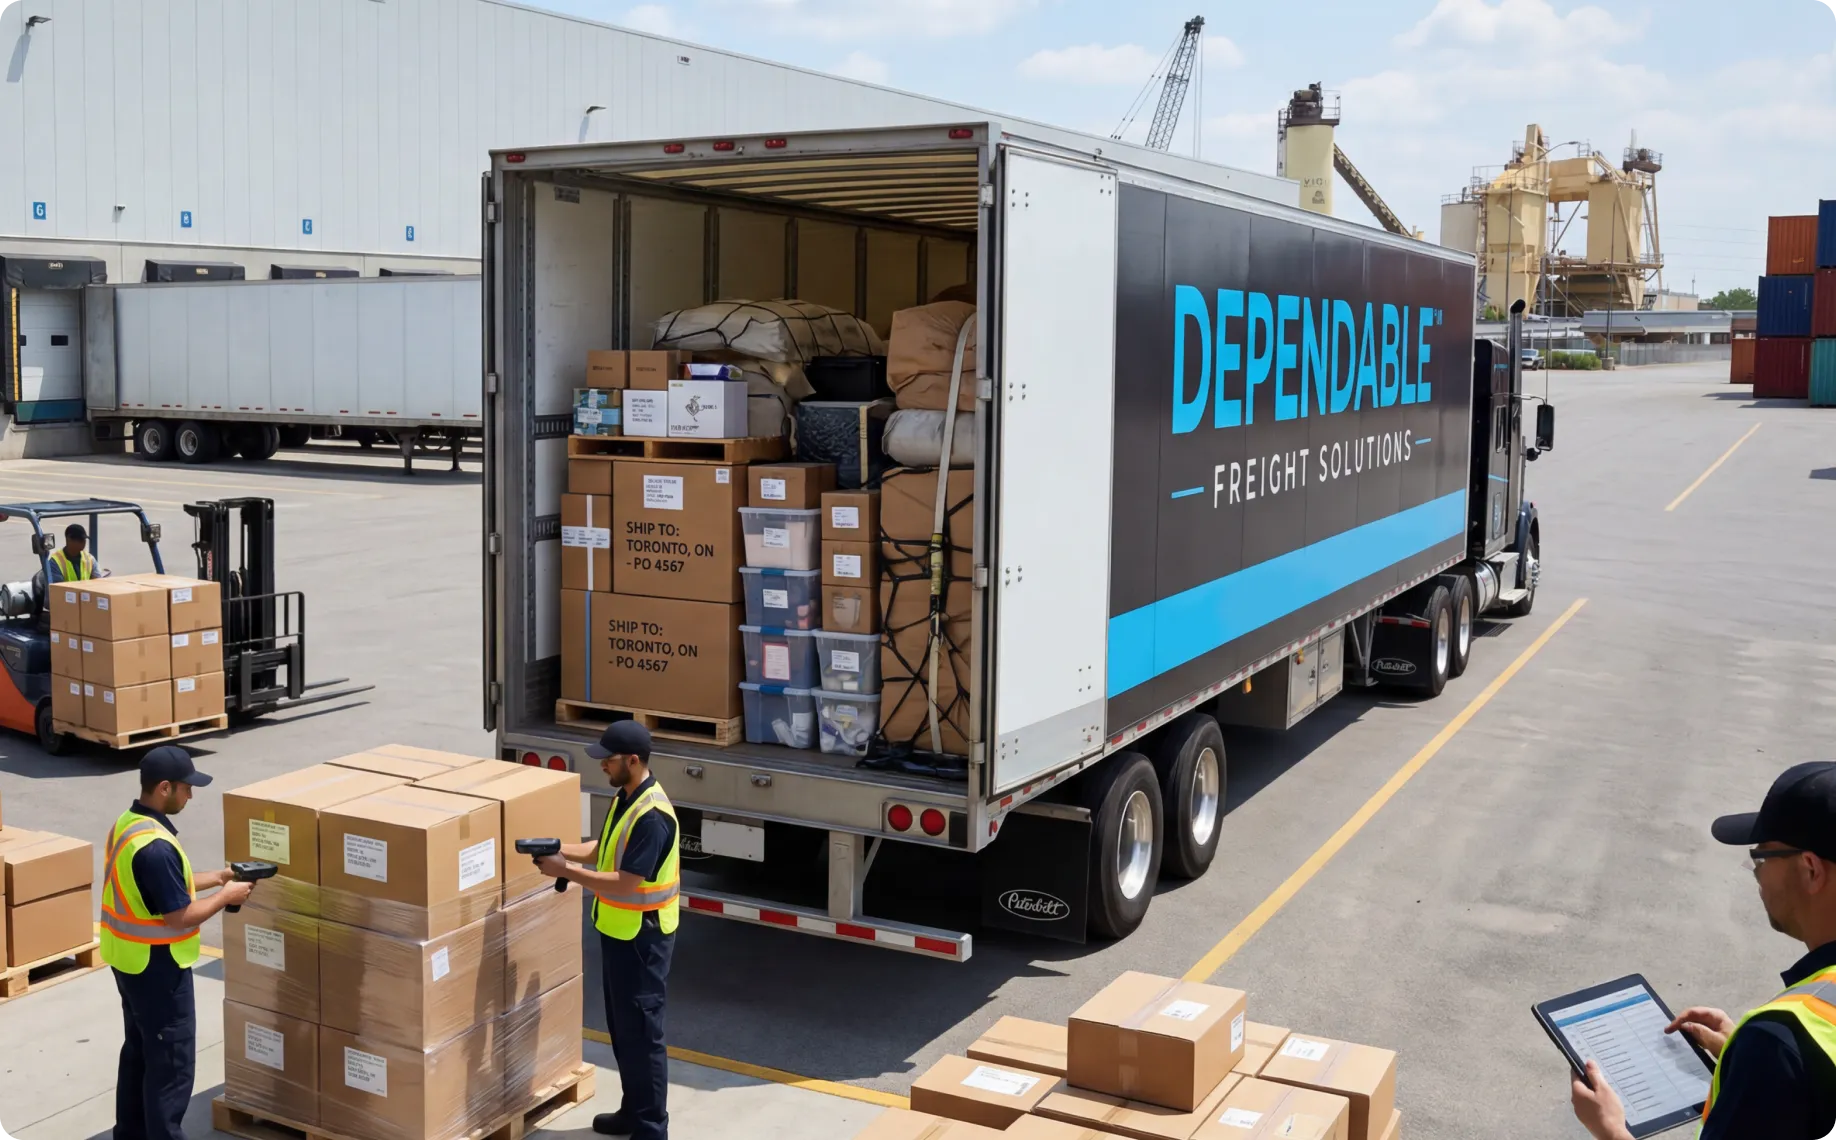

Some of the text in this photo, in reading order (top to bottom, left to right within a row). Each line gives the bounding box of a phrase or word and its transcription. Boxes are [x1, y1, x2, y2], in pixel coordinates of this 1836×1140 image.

[36, 204, 44, 217] 6
[1172, 284, 1434, 434] DEPENDABLE
[1213, 429, 1412, 509] FREIGHT SOLUTIONS
[626, 521, 680, 537] SHIP TO:
[626, 539, 714, 558] TORONTO, ON
[634, 558, 651, 570] PO
[655, 559, 685, 573] 4567
[608, 619, 663, 636] SHIP TO:
[608, 637, 698, 657] TORONTO, ON
[616, 656, 634, 669] PO
[637, 658, 668, 672] 4567
